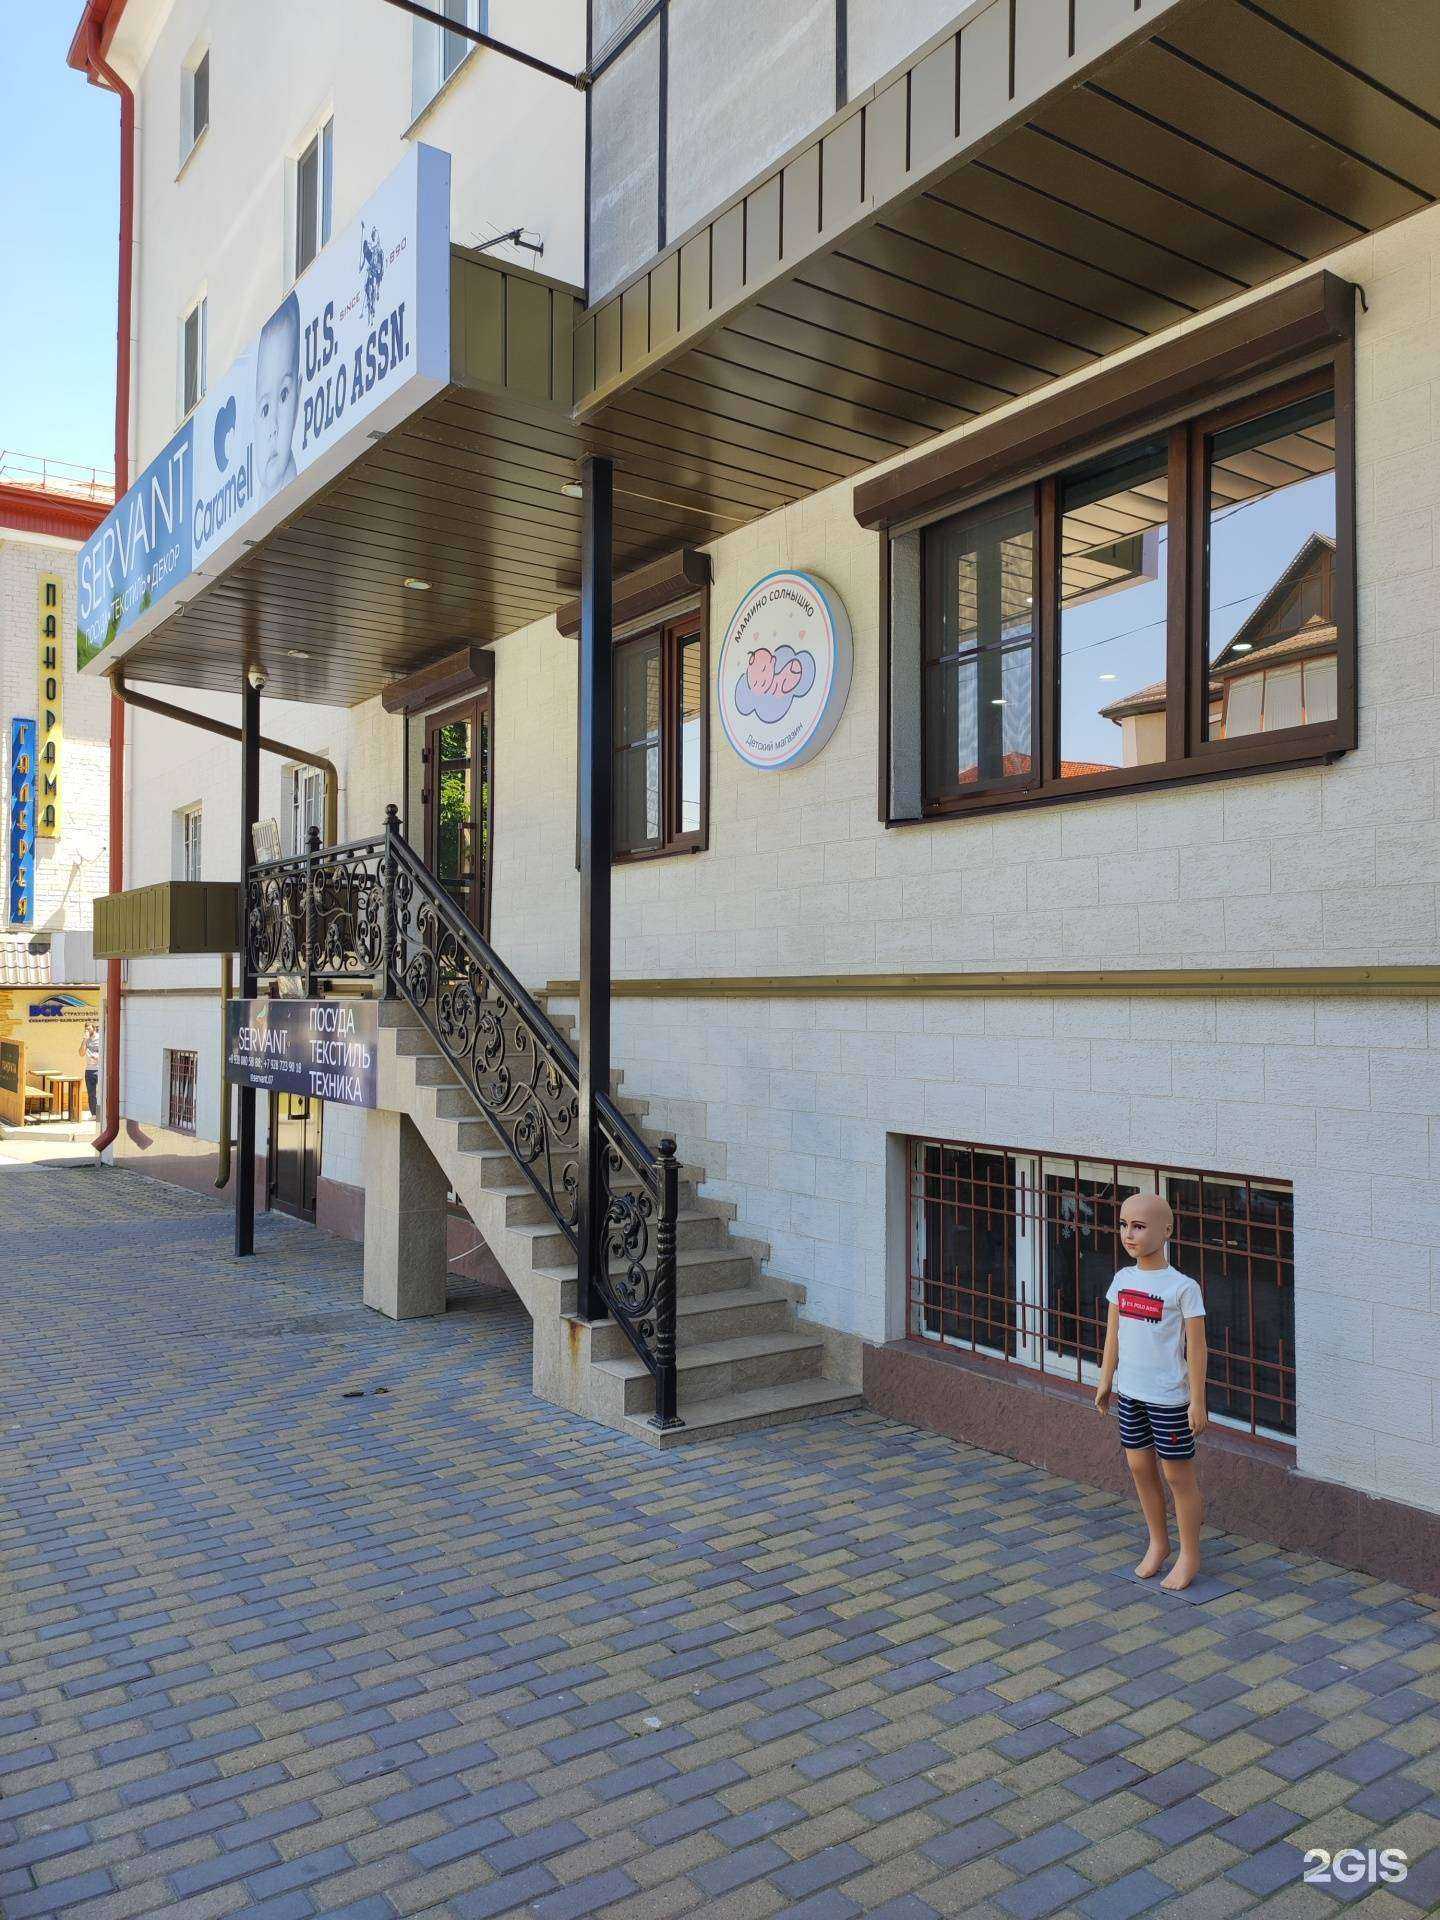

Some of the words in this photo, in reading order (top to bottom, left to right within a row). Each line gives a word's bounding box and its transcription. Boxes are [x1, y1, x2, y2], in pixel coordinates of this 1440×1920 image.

[339, 290, 361, 321] SINCE
[385, 236, 407, 268] 1890
[302, 363, 347, 450] POLO
[350, 302, 410, 405] ASSN.
[304, 301, 338, 383] U.S.
[80, 440, 189, 620] SERVANT
[193, 443, 253, 550] Caramell
[111, 576, 147, 621] ТЕКСТИЛЬ
[151, 544, 180, 592] ДЕКОР
[734, 597, 768, 643] МАМИНО
[769, 588, 815, 618] СОЛНЫШКО
[42, 583, 58, 828] ПАНОРАМА
[745, 733, 774, 752] Детский
[775, 721, 804, 750] магазин
[238, 1027, 288, 1055] SERVANT
[309, 1007, 355, 1038] ПОСУДА
[309, 1040, 371, 1069] ТЕКСТИЛЬ
[309, 1071, 363, 1102] ТЕХНИКА
